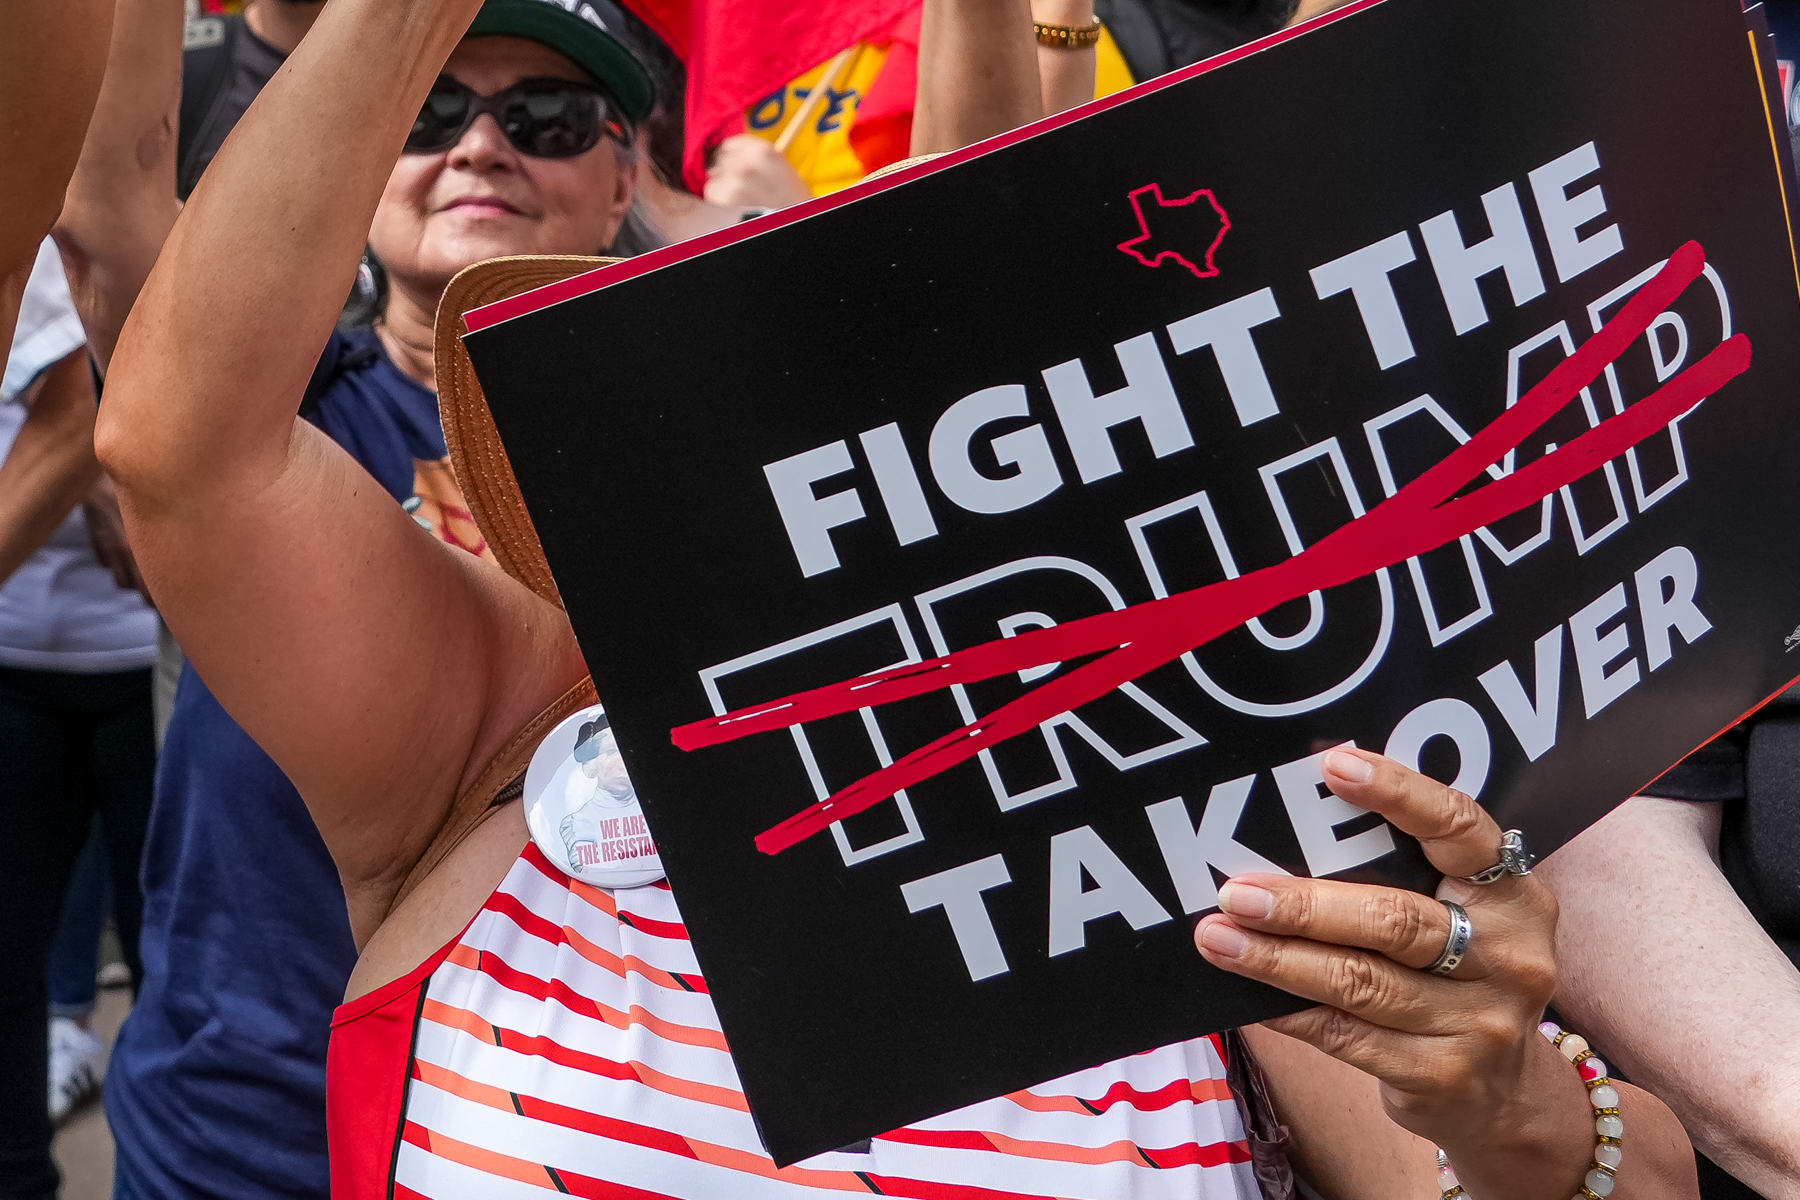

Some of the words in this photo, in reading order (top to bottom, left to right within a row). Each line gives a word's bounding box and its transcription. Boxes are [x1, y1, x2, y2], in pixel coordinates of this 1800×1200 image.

[698, 257, 1734, 867] TRUMP
[762, 287, 1283, 579] FIGHT
[1310, 140, 1625, 370] THE
[576, 843, 600, 866] THE
[601, 835, 657, 864] RESISTA
[600, 817, 621, 839] WE
[623, 814, 647, 837] ARE
[900, 545, 1713, 983] TAKEOVER
